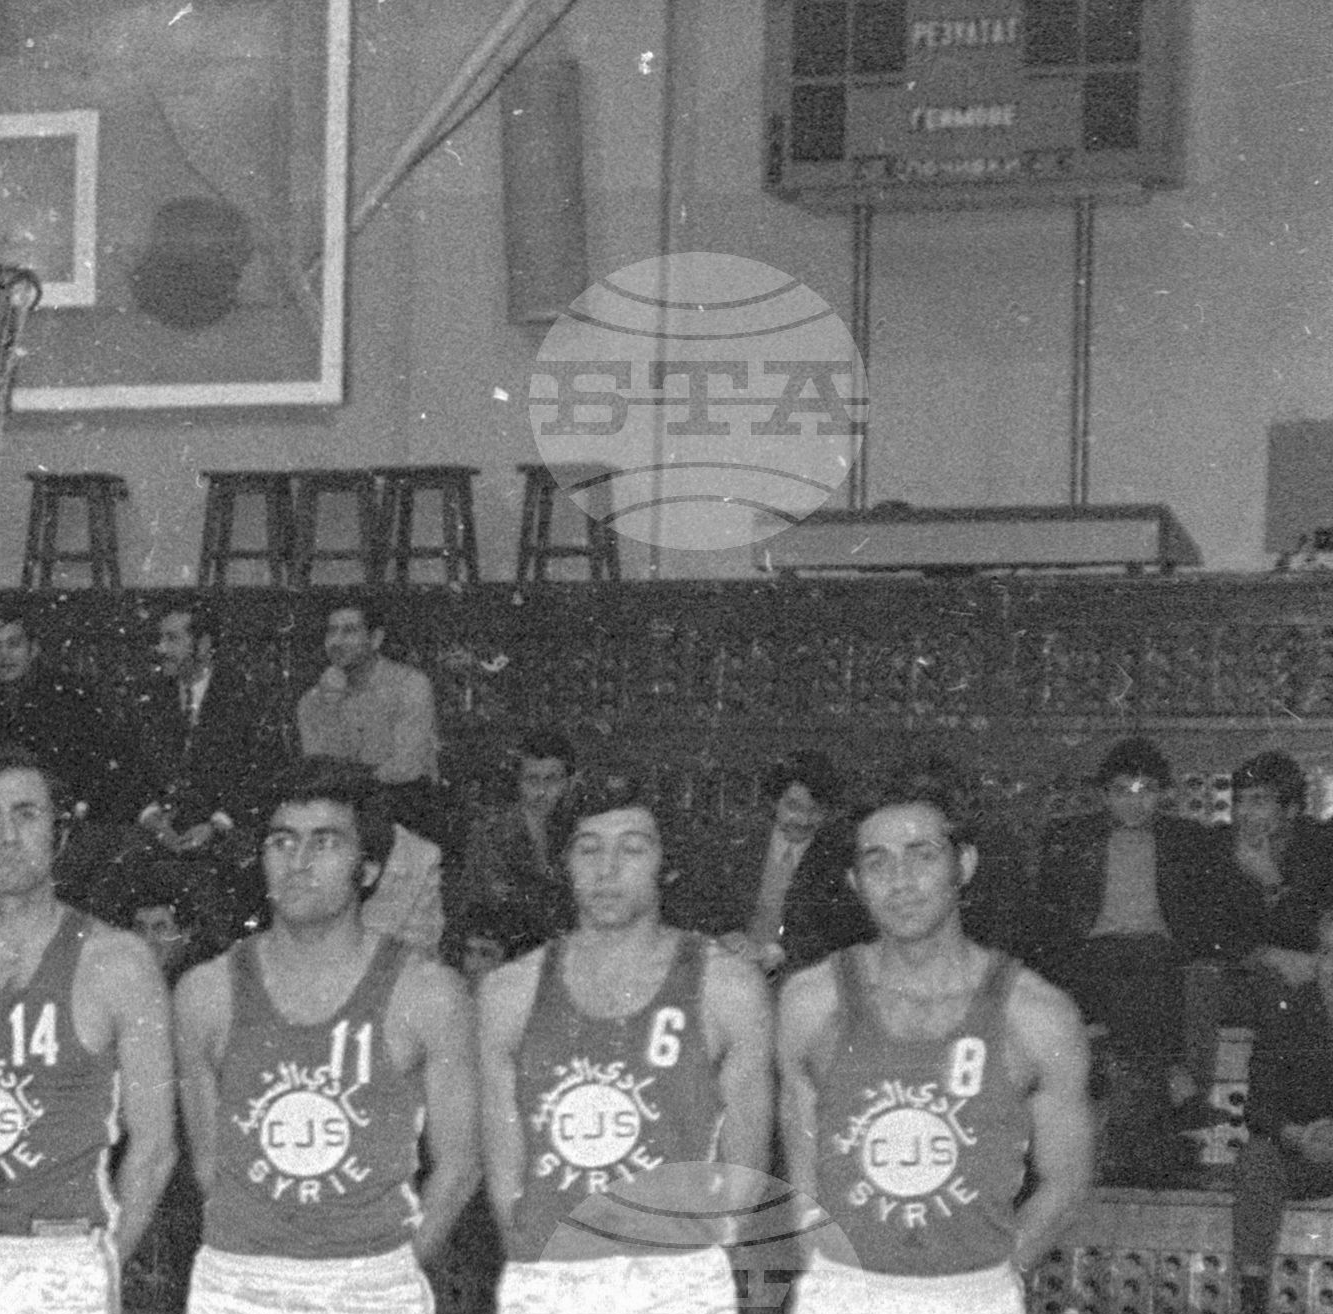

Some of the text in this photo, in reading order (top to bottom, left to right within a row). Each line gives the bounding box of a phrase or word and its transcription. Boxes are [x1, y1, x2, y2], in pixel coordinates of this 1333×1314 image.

[10, 1003, 59, 1067] 14
[332, 1020, 372, 1084] 11
[648, 1006, 686, 1067] 6
[949, 1036, 986, 1097] 8
[269, 1118, 345, 1148] CJS
[560, 1112, 635, 1141] CJS
[871, 1136, 953, 1167] CJS
[248, 1156, 372, 1204] SYRIE
[536, 1146, 664, 1193] SYRIE
[848, 1176, 980, 1228] SYRIE
